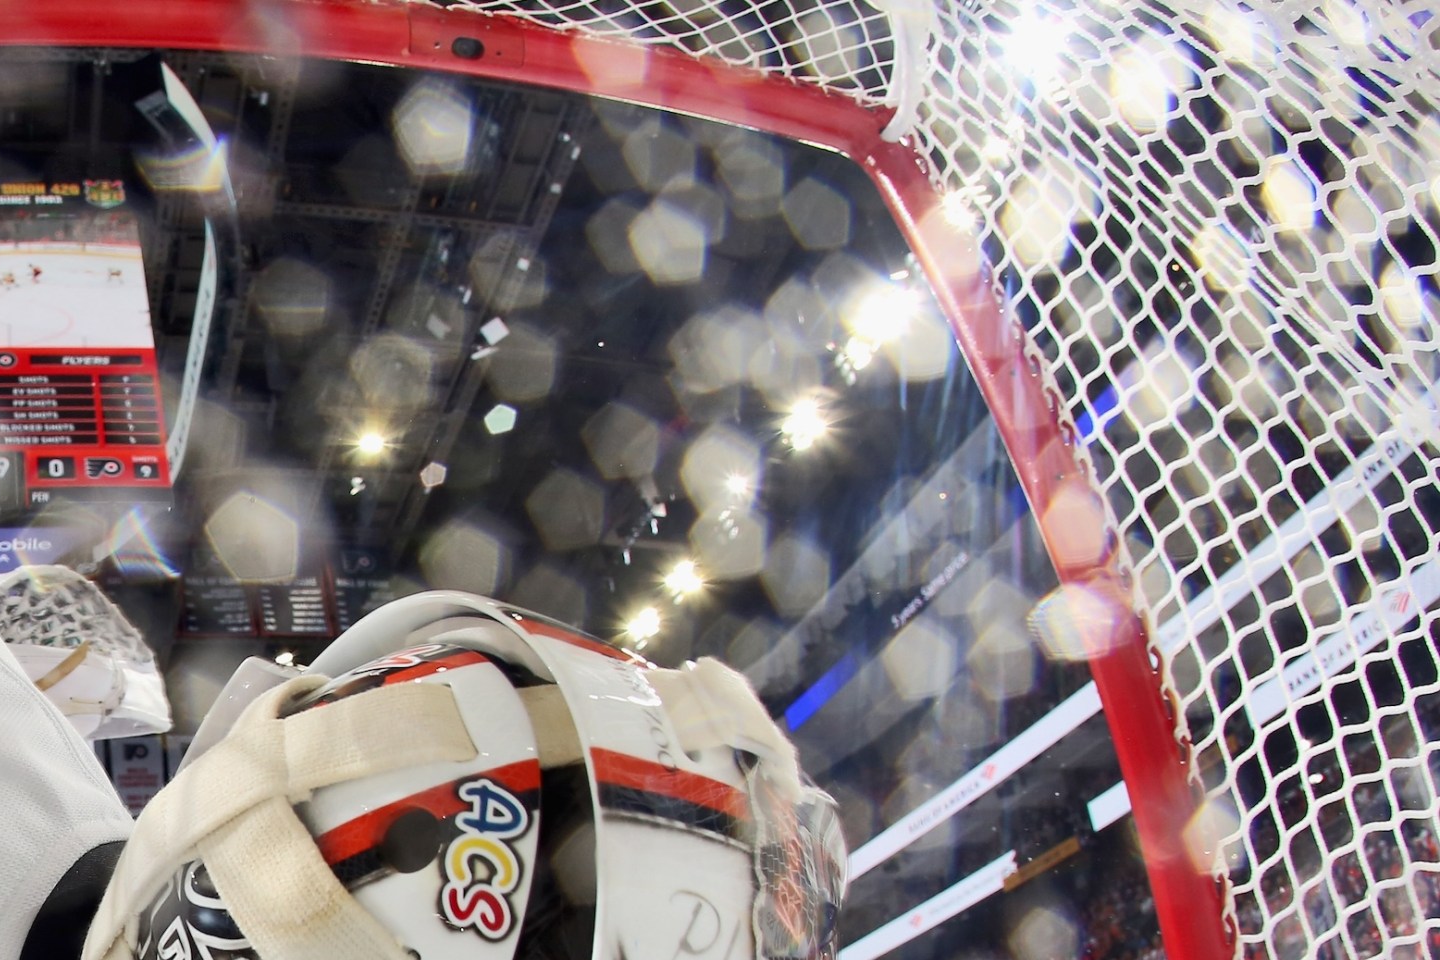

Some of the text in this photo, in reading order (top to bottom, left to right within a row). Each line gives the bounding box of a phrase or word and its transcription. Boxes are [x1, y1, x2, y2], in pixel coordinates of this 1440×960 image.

[62, 356, 110, 365] FLYERS
[49, 459, 65, 477] 0
[139, 466, 153, 478] 9
[443, 779, 528, 941] ACS
